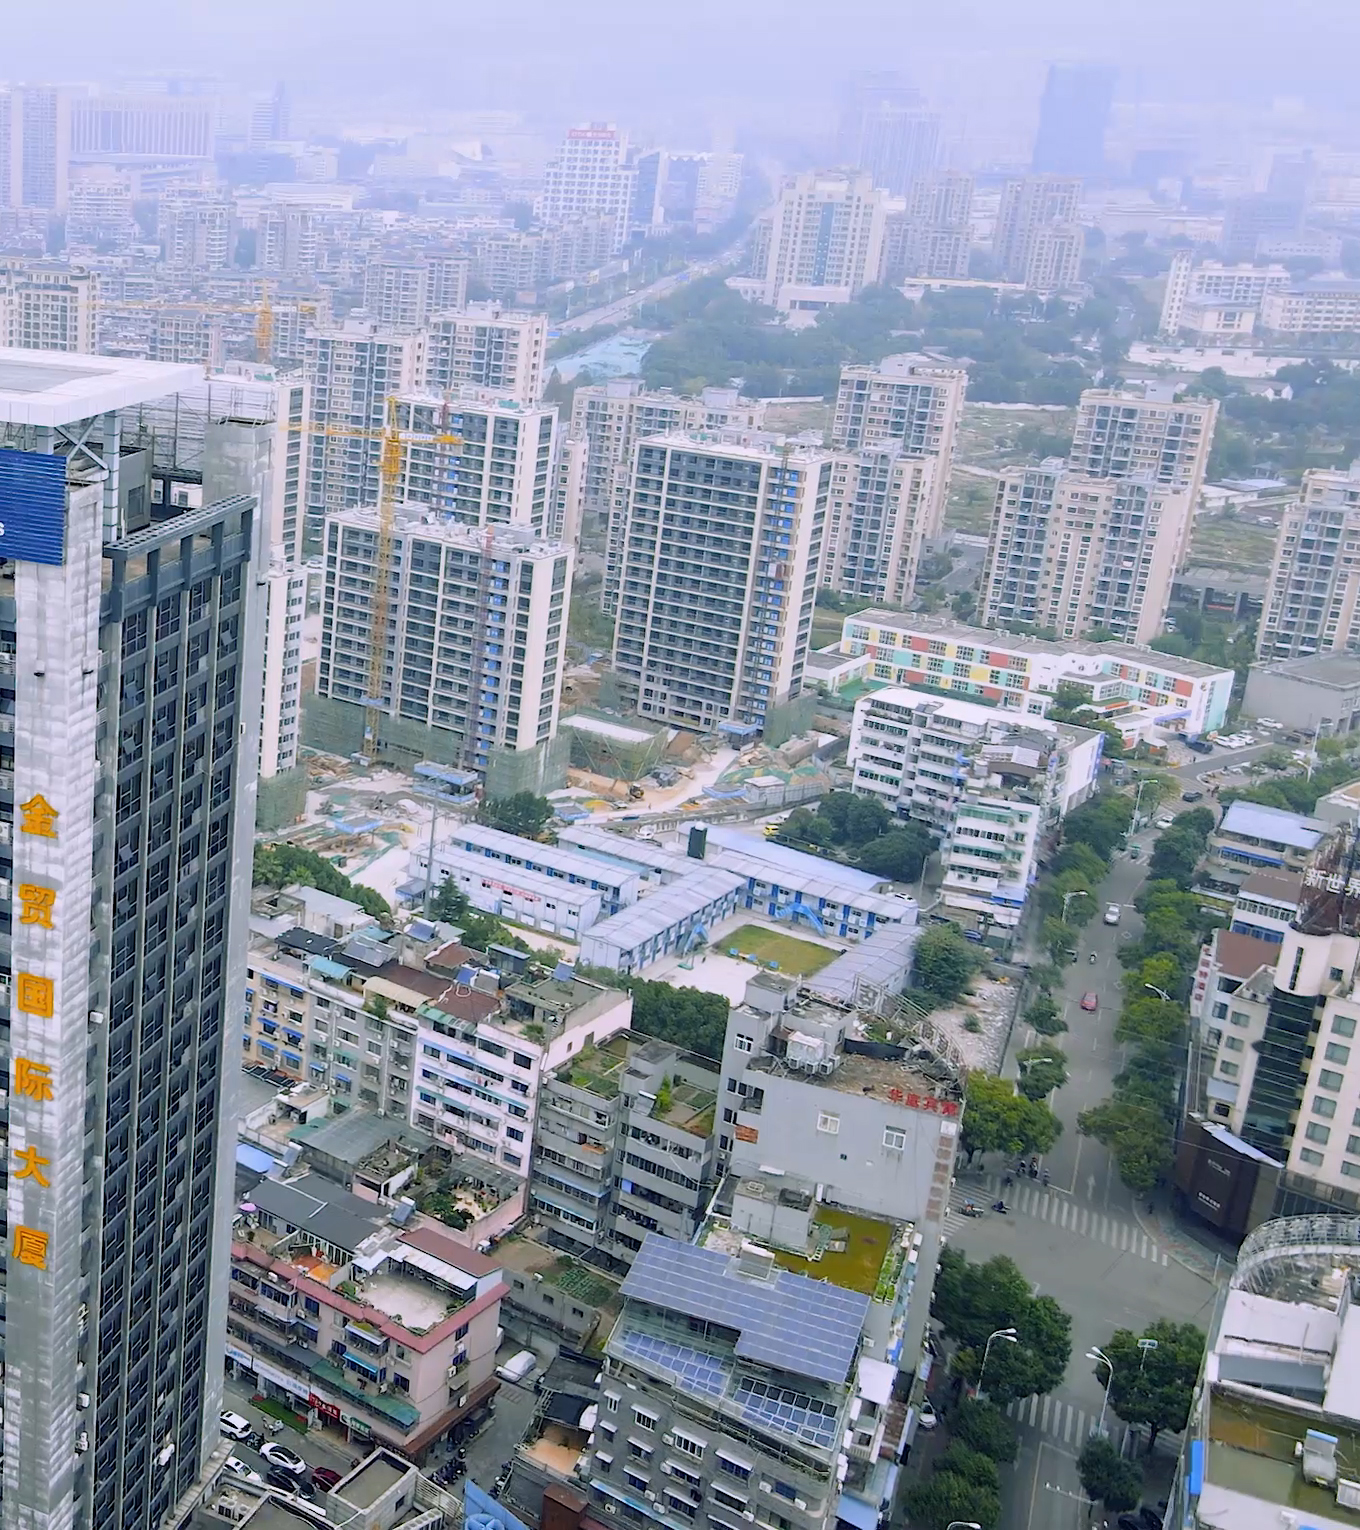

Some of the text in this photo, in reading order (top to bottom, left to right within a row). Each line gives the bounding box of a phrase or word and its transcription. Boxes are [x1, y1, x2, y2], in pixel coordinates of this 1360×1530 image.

[11, 793, 59, 1271] 金贸国际大厦
